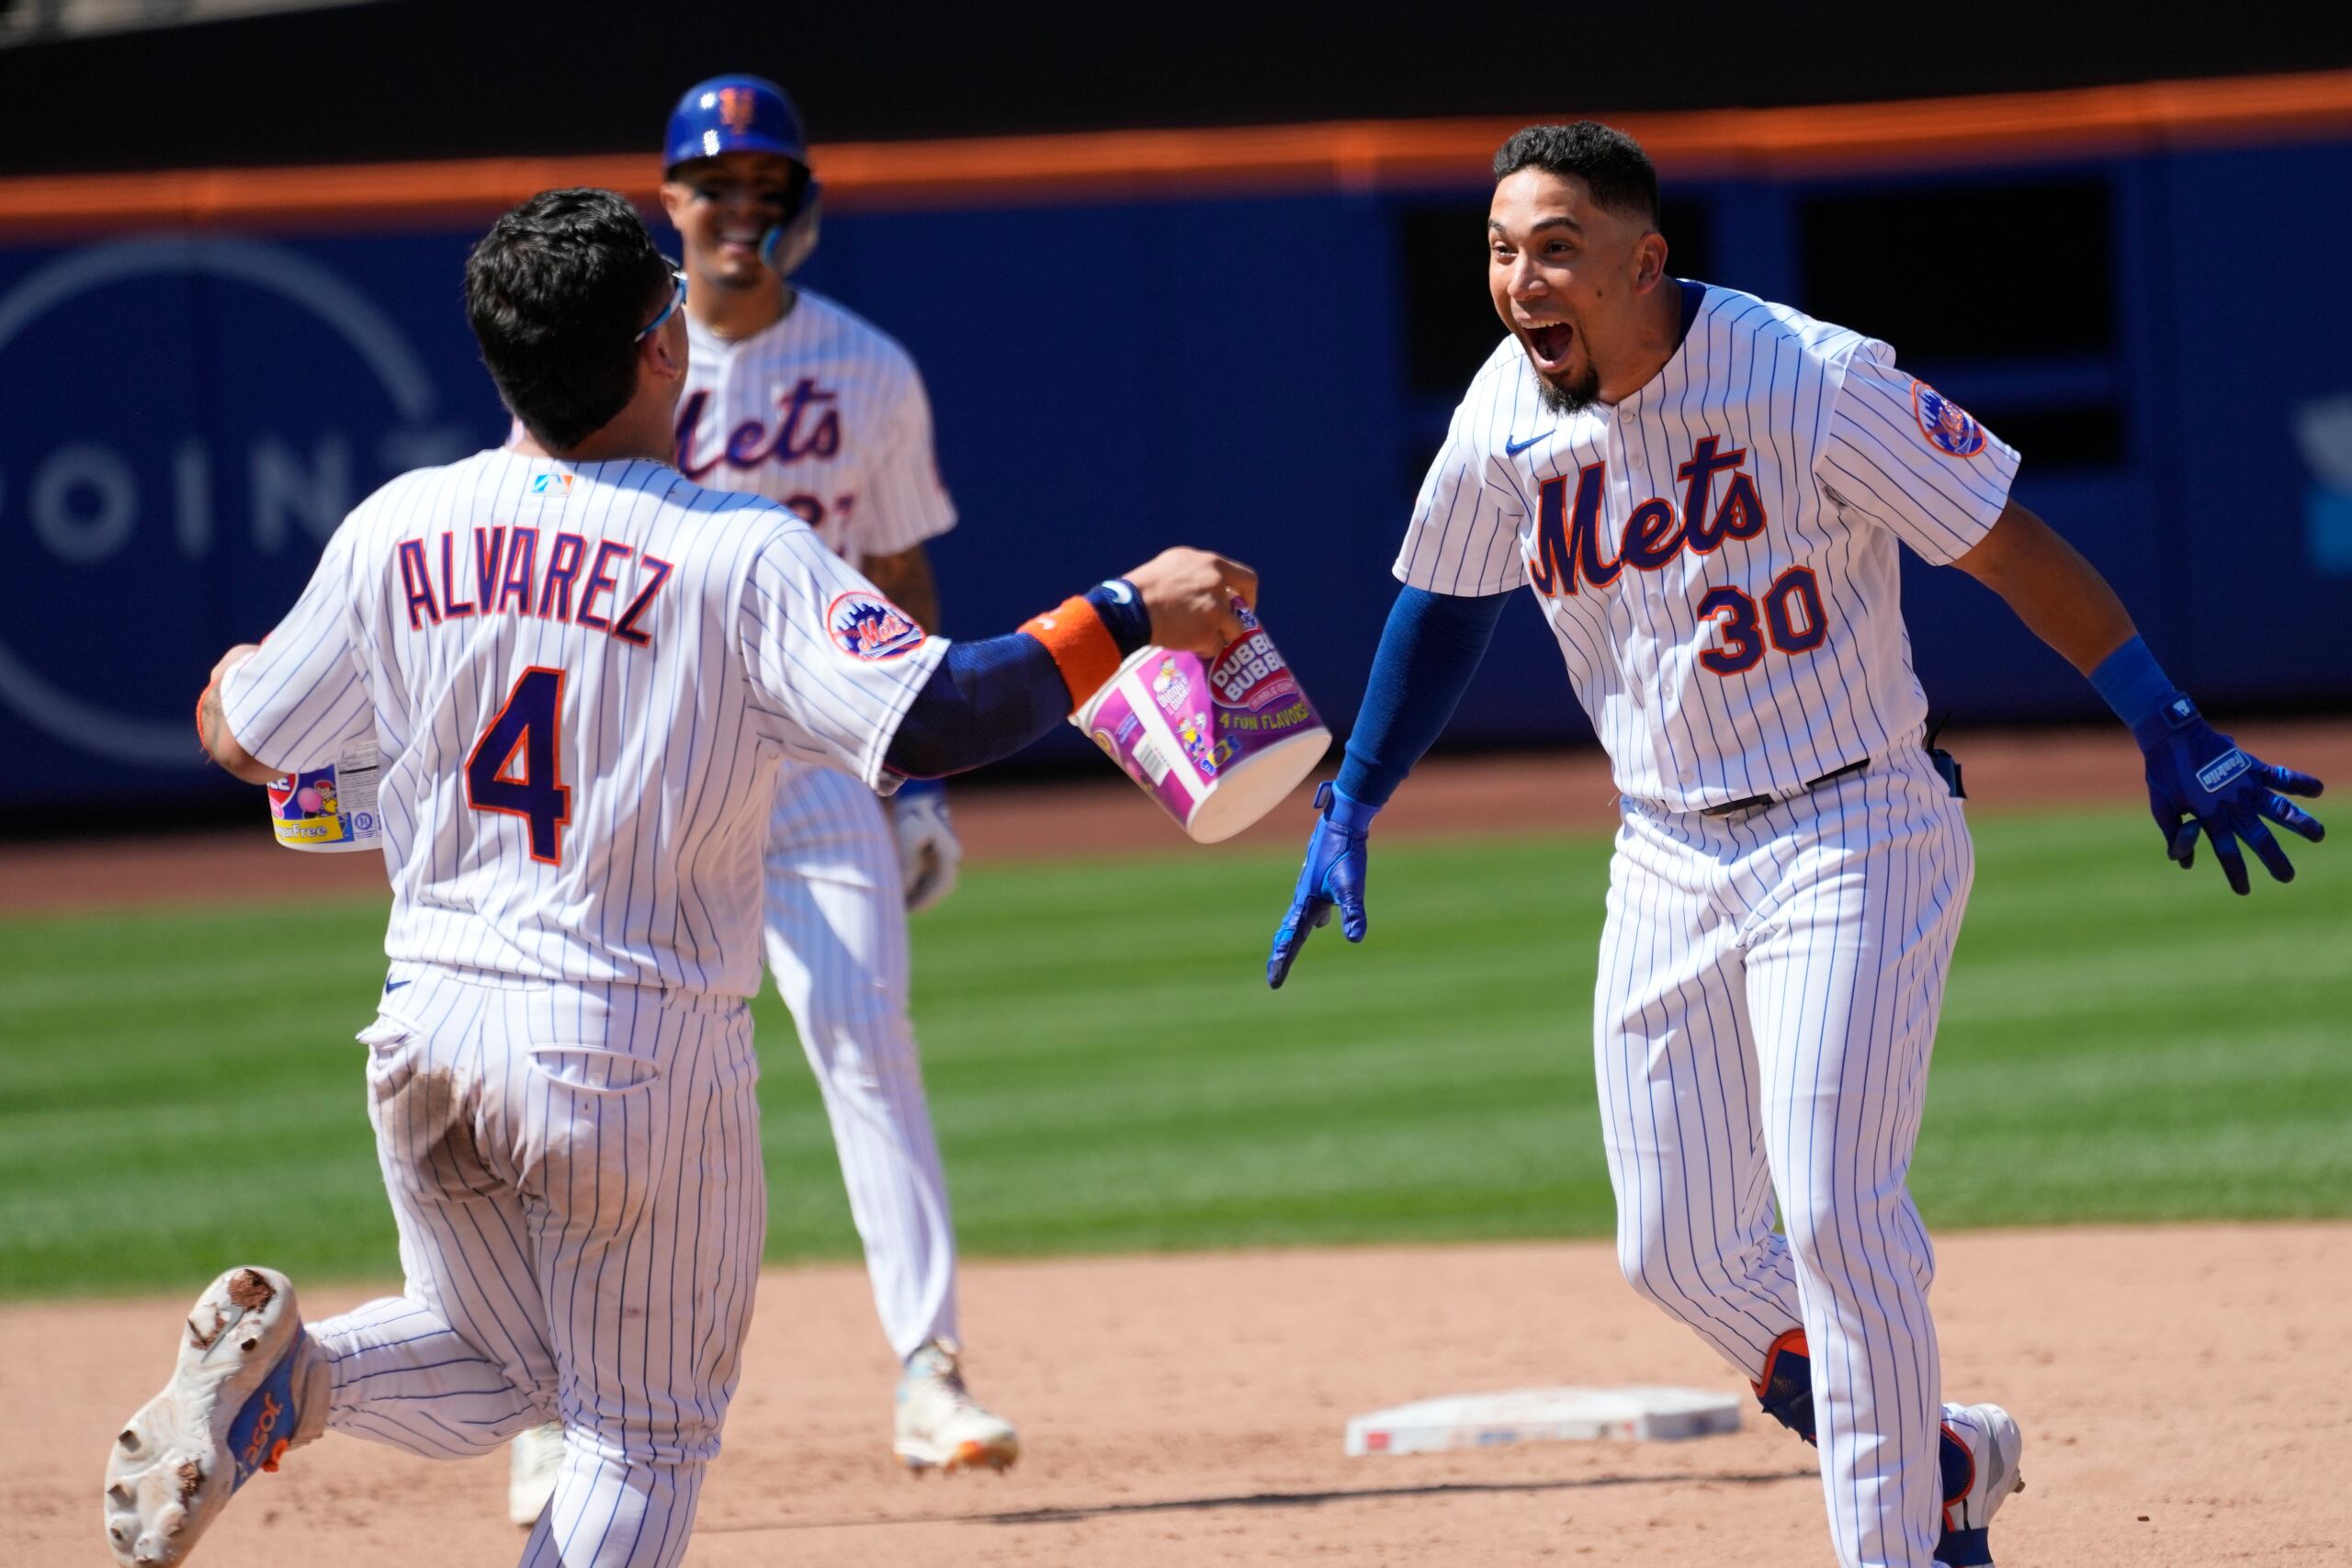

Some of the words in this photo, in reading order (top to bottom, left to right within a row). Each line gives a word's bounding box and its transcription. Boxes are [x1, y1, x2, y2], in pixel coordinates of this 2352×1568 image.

[0, 427, 472, 564] OIN
[1529, 434, 1767, 597] Mets
[399, 525, 674, 649] ALVAREZ
[1697, 566, 1828, 677] 30
[1219, 713, 1230, 728] 4
[1234, 716, 1258, 730] FUN
[1224, 649, 1286, 702] BUBBL
[464, 665, 571, 866] 4
